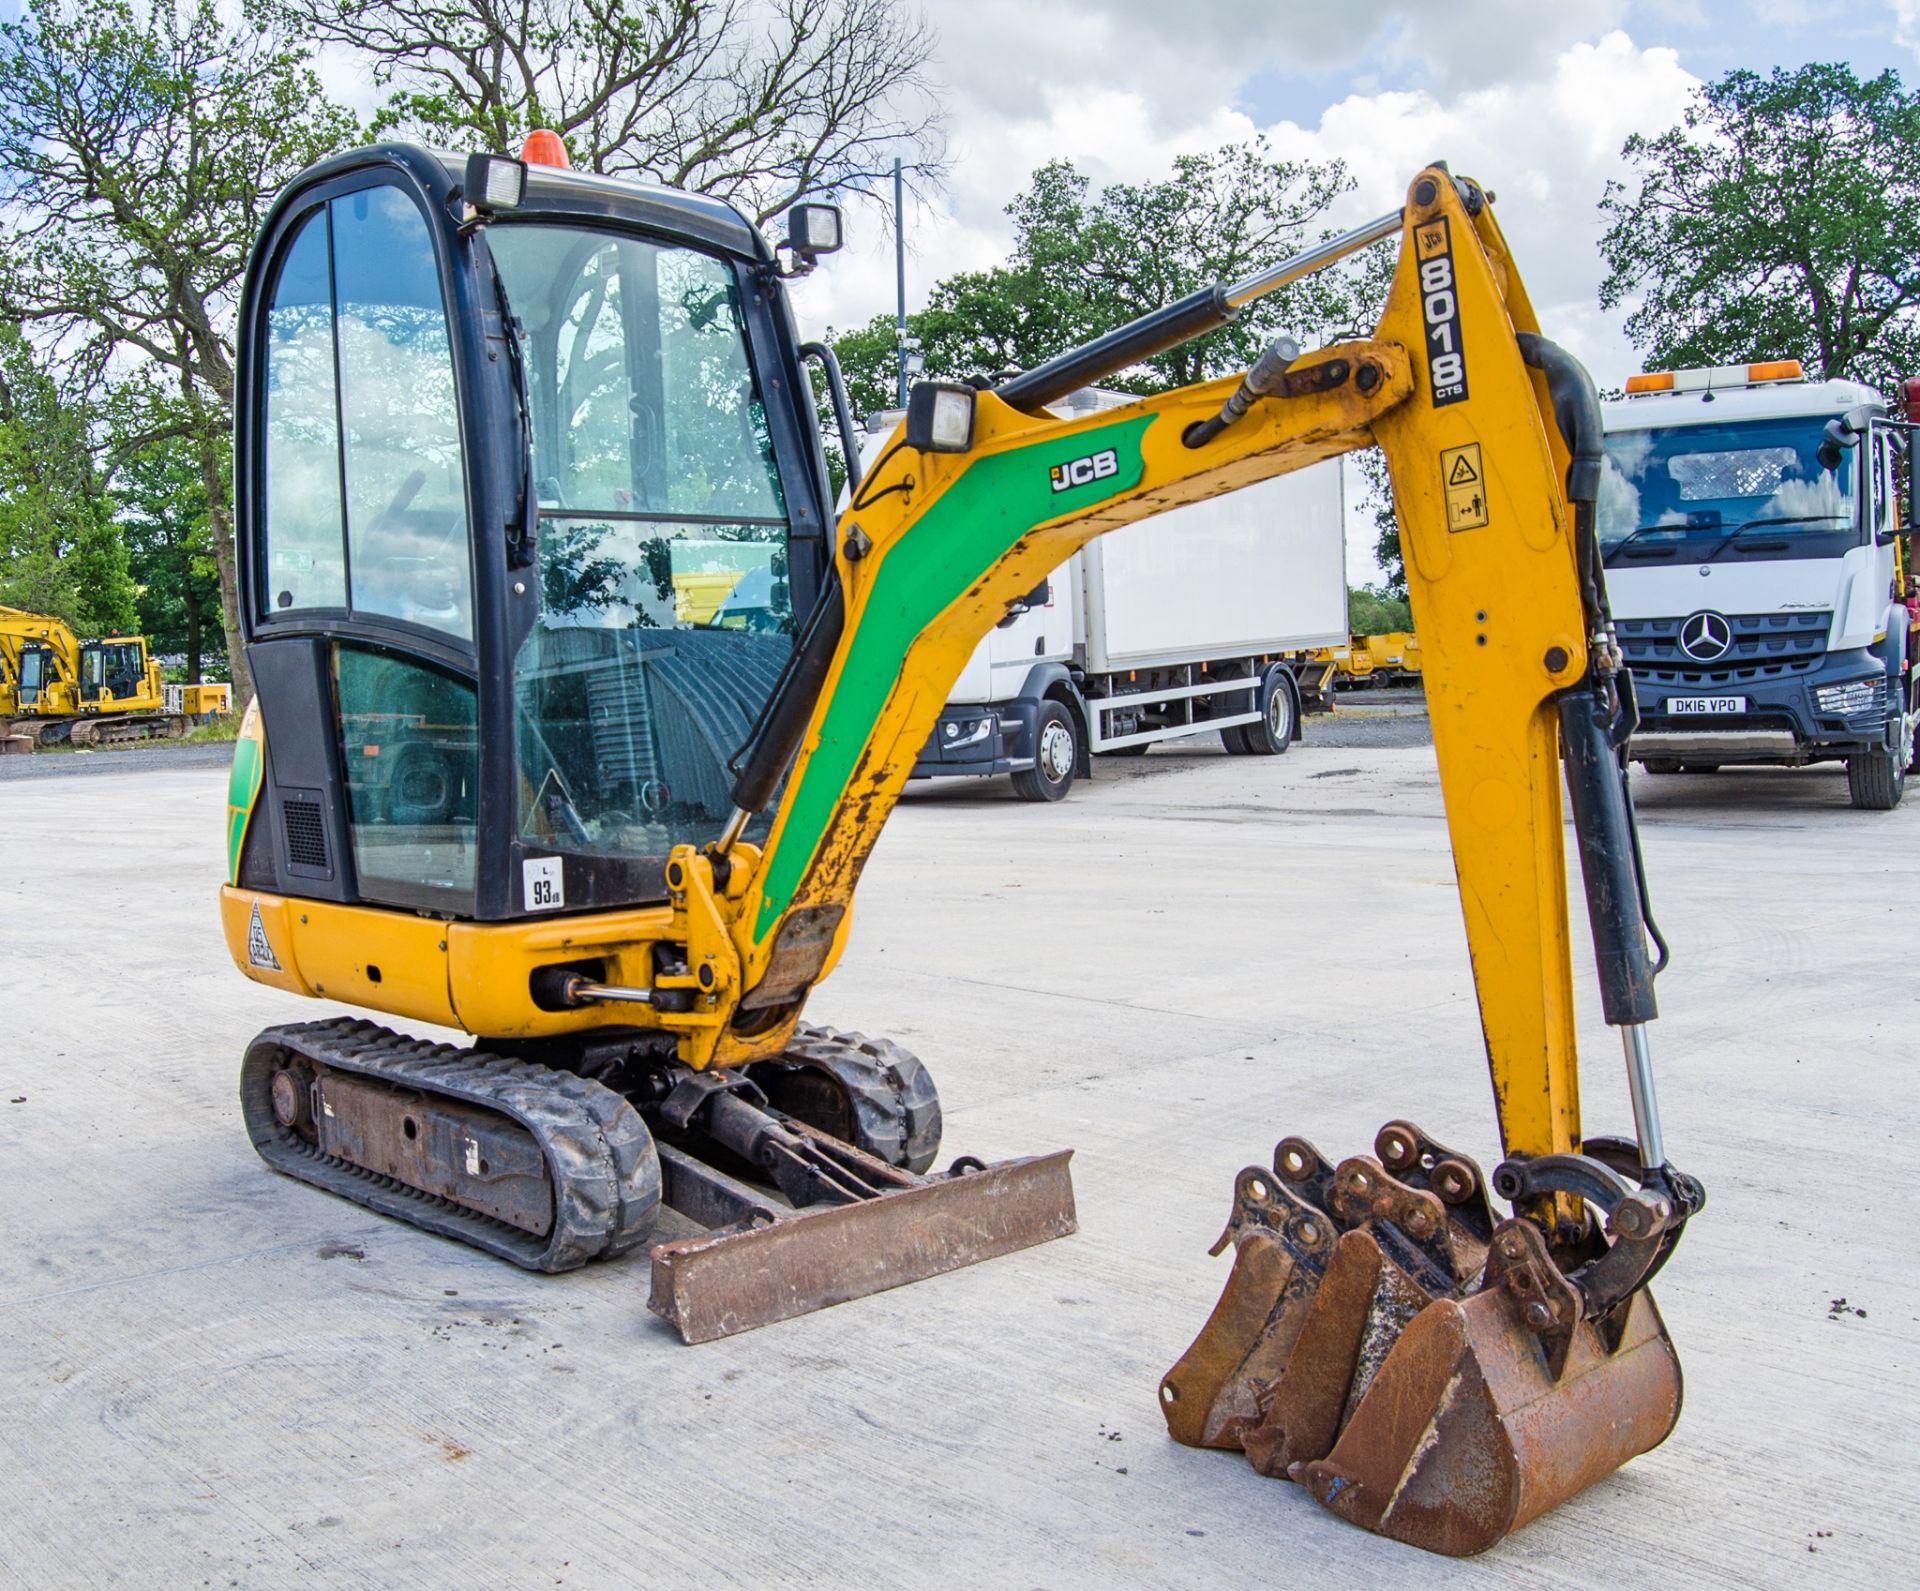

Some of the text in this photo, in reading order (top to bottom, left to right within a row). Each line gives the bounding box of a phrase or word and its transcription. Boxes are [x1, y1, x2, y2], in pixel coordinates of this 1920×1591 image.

[1424, 231, 1443, 250] JCB
[1421, 258, 1463, 387] 8018
[1436, 384, 1463, 398] CTS
[1052, 450, 1117, 491] JCB
[1676, 699, 1736, 712] DK16 VPO
